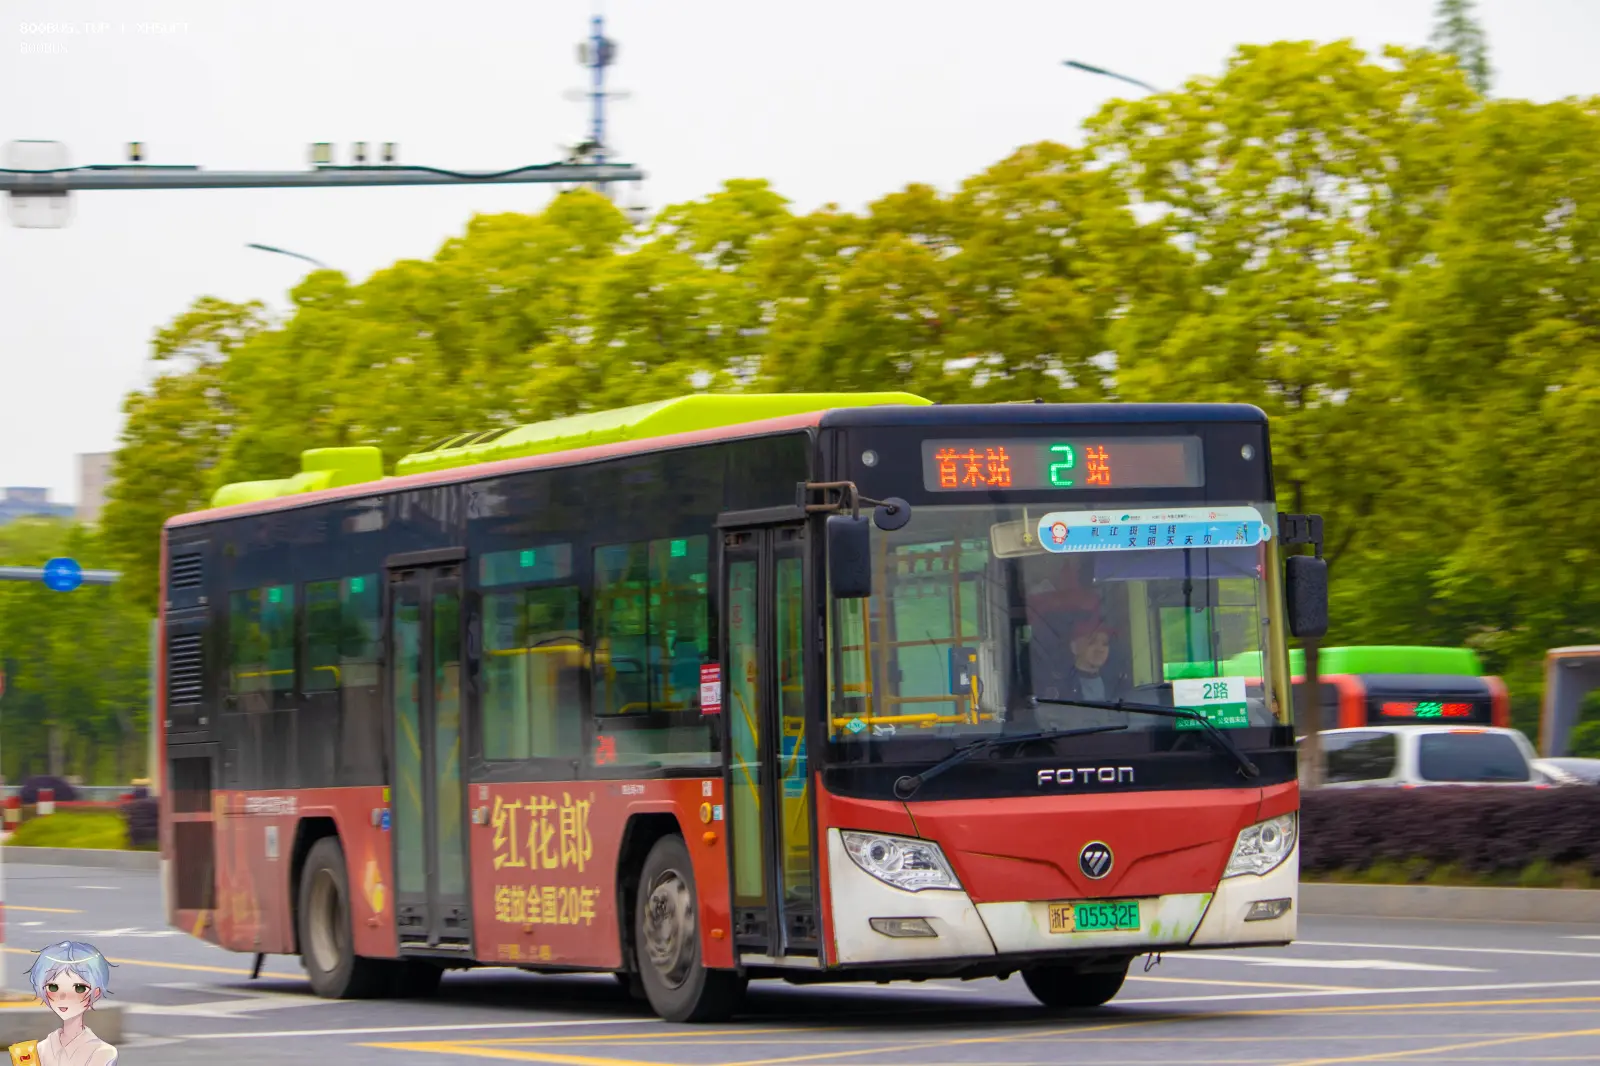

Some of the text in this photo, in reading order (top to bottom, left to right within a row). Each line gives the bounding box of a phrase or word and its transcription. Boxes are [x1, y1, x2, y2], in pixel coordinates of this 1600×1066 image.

[936, 444, 1111, 487] 首末站 2 站
[1091, 524, 1176, 537] 礼让斑马线
[1128, 534, 1212, 547] 文明天天见
[1203, 682, 1228, 700] 2路
[1037, 766, 1134, 786] FOTON
[491, 792, 593, 873] 红花郎
